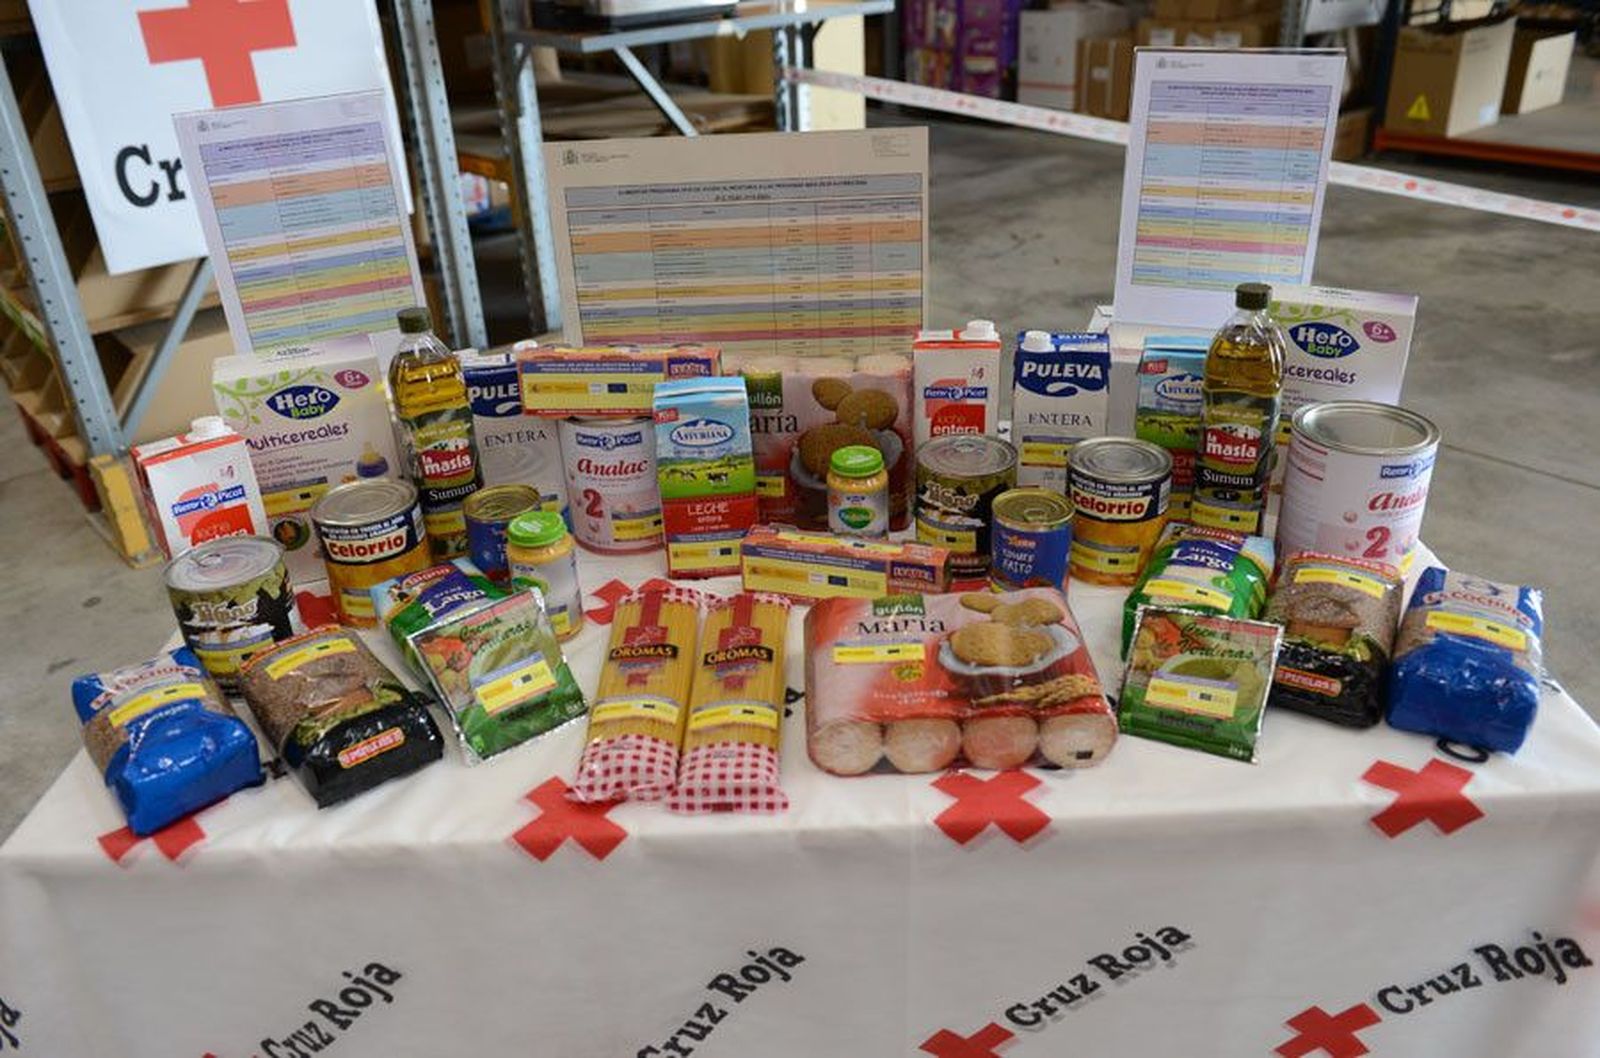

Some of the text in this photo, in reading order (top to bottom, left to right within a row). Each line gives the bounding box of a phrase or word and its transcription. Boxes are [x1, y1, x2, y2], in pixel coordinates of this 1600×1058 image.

[115, 145, 186, 207] Cr
[1297, 326, 1353, 348] Hero
[1307, 344, 1342, 358] Baby
[1022, 361, 1102, 380] PULEVA
[1284, 365, 1357, 385] cereales
[274, 387, 332, 411] Hero
[469, 382, 519, 401] PULE
[748, 392, 781, 404] ullón
[292, 403, 325, 419] Baby
[1028, 413, 1093, 427] ENTERA
[750, 410, 799, 434] aría
[484, 429, 547, 448] ENTERA
[577, 457, 649, 478] analac
[1203, 469, 1254, 485] Sumum
[429, 483, 477, 501] Sumum
[583, 487, 603, 518] 2
[329, 534, 405, 557] Celorrio
[1362, 526, 1391, 558] 2
[1168, 548, 1235, 571] Largo
[856, 616, 946, 636] María
[612, 645, 673, 658] OROMAS
[707, 649, 768, 664] OROMAS
[706, 947, 805, 1003] Roja
[1004, 926, 1191, 1027] Cruz Roja
[1377, 931, 1593, 1014] Cruz Roja
[260, 963, 402, 1058] Cruz Roja
